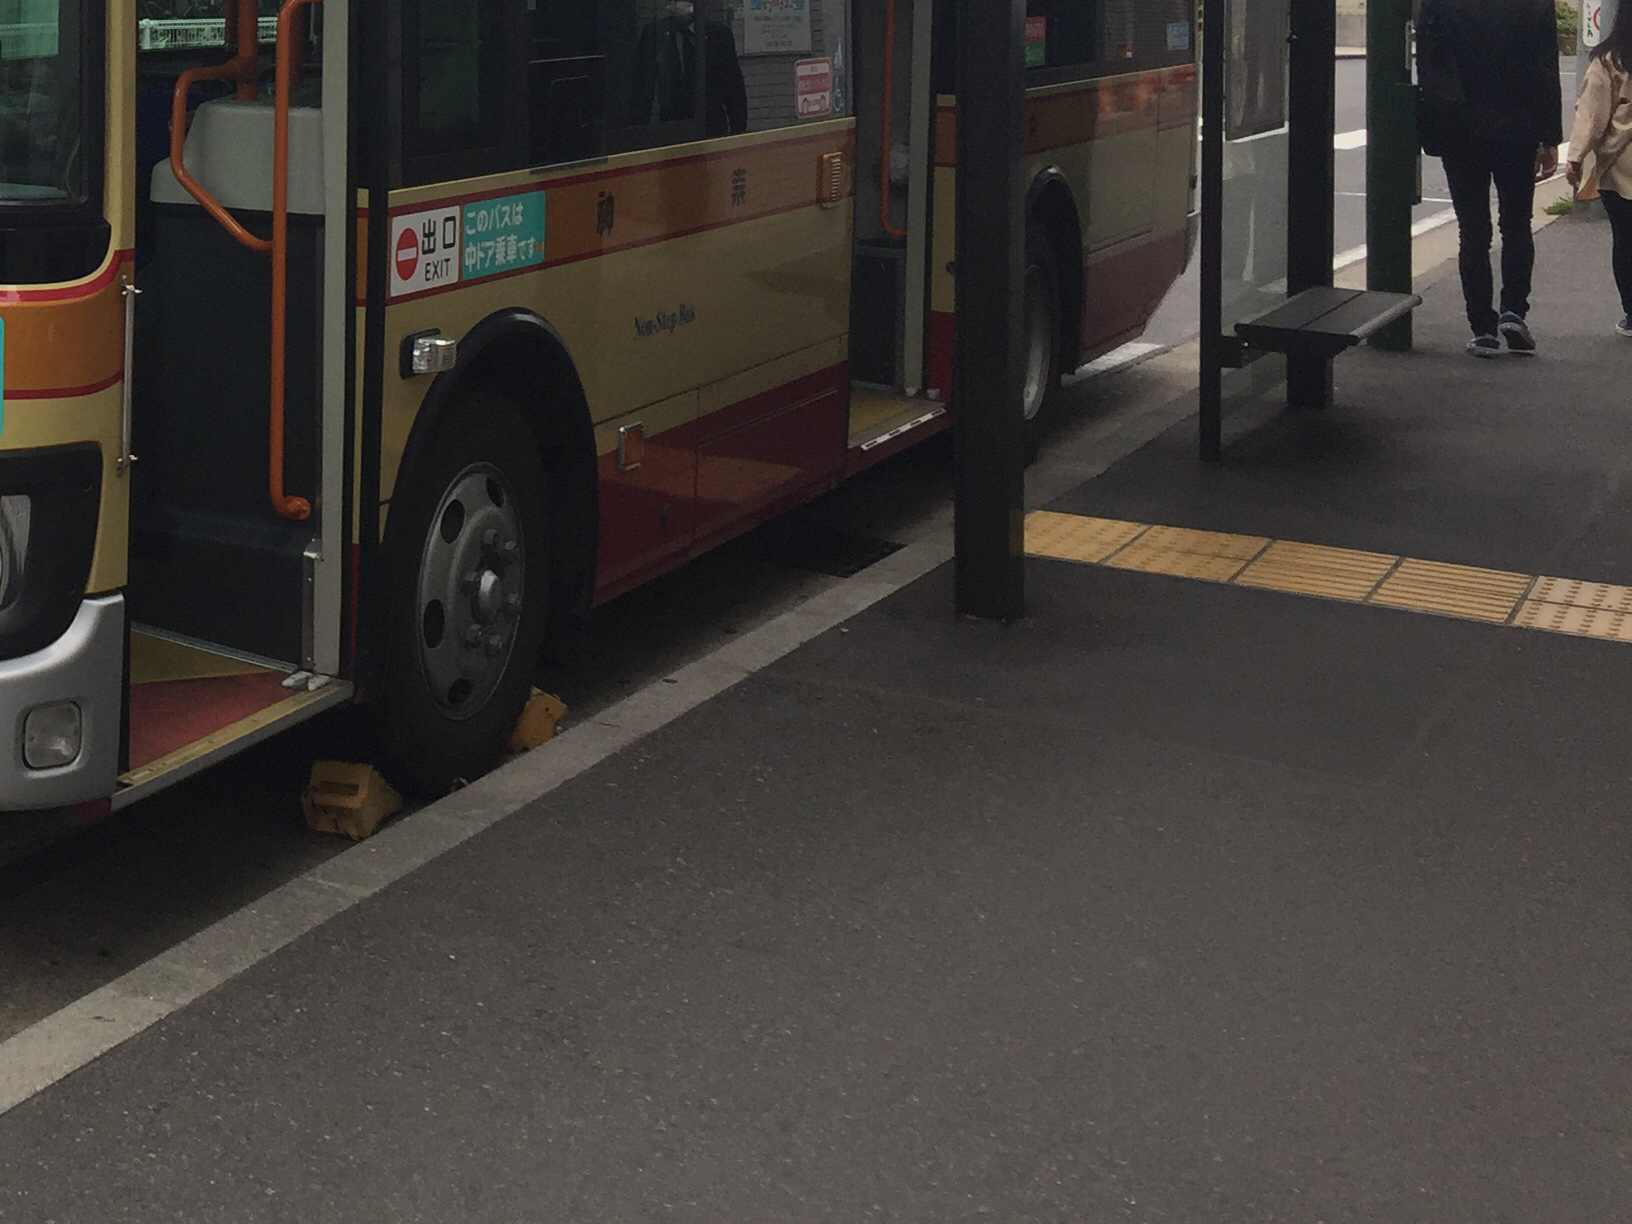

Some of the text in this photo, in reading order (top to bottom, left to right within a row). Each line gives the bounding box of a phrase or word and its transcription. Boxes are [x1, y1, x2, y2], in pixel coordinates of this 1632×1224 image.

[421, 215, 457, 256] 出口
[465, 201, 524, 236] このバスは
[424, 258, 451, 282] EXIT
[464, 233, 537, 273] 中ドア乗車です
